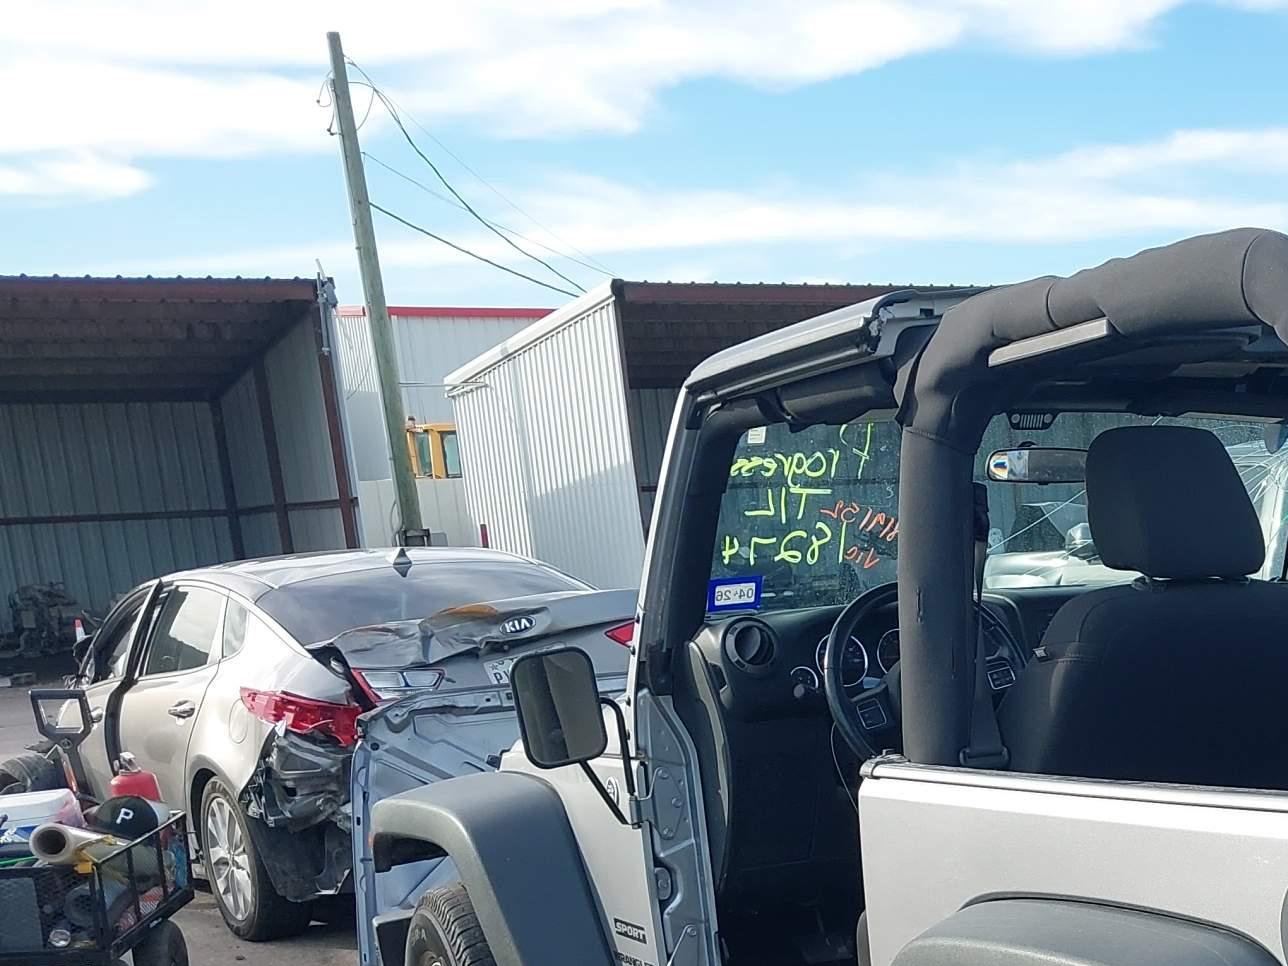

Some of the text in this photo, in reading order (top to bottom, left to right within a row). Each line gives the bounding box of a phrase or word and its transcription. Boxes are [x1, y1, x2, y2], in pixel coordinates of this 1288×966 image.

[504, 618, 531, 633] KIA
[115, 807, 135, 825] P
[615, 921, 646, 940] SPORT
